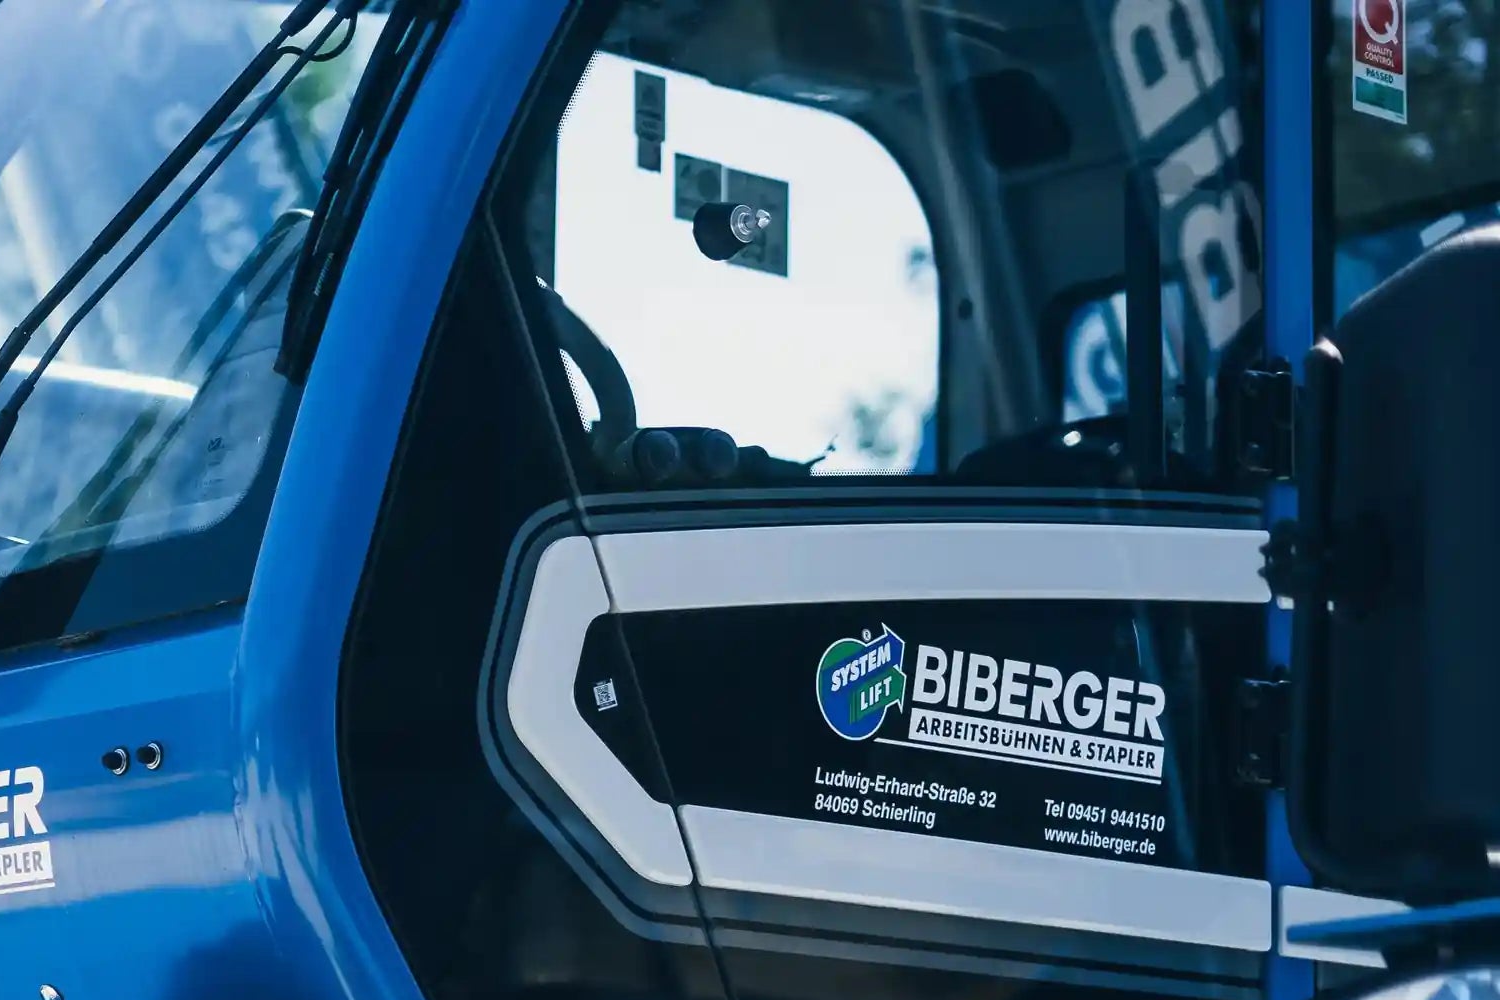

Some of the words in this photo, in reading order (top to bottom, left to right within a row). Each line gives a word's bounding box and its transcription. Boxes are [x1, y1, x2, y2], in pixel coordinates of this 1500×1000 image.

[1364, 51, 1395, 68] CONTROL
[1366, 42, 1393, 57] QUALITY
[1366, 67, 1394, 83] PASSED
[831, 641, 891, 691] SYSTEM
[861, 676, 892, 711] LIFT
[912, 644, 1166, 741] BIBERGER
[916, 716, 1065, 756] ARBEITSBÜHNEN
[1070, 739, 1082, 758] &
[1086, 742, 1156, 769] STAPLER
[815, 766, 976, 806] Ludwig-Erhard-Straße
[978, 790, 997, 808] 32
[815, 793, 858, 815] 84069
[862, 799, 936, 829] Schierling
[1044, 799, 1065, 818] Tel
[1067, 803, 1106, 823] 09451
[1110, 809, 1166, 832] 9441510
[1044, 828, 1156, 855] www.biberger.de
